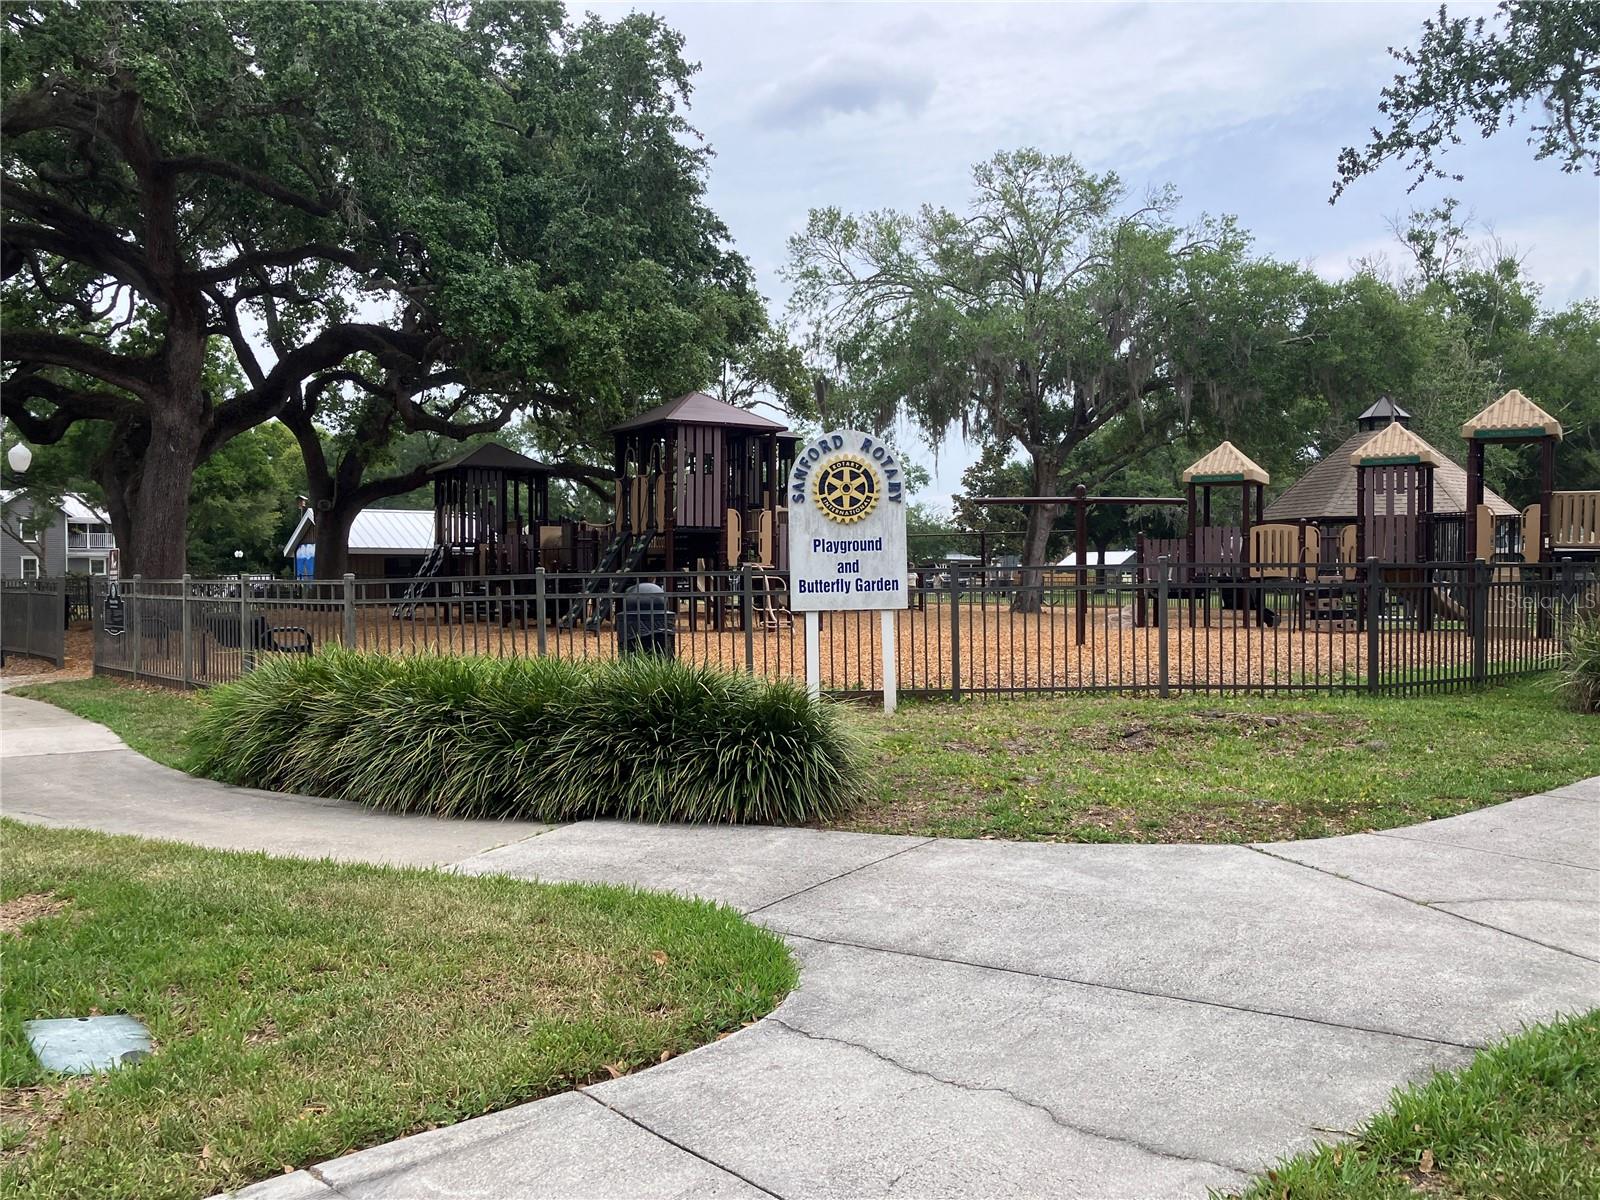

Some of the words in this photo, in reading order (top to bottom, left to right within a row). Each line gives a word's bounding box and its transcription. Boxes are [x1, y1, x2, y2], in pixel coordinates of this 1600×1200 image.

[792, 435, 844, 504] SANFORD
[860, 437, 902, 504] ROTARY
[832, 462, 861, 470] ROTARY
[822, 497, 872, 516] INTERNATIONAL
[813, 537, 883, 554] Playground
[837, 559, 860, 574] and
[799, 579, 851, 594] Butterfly
[855, 577, 899, 592] Garden
